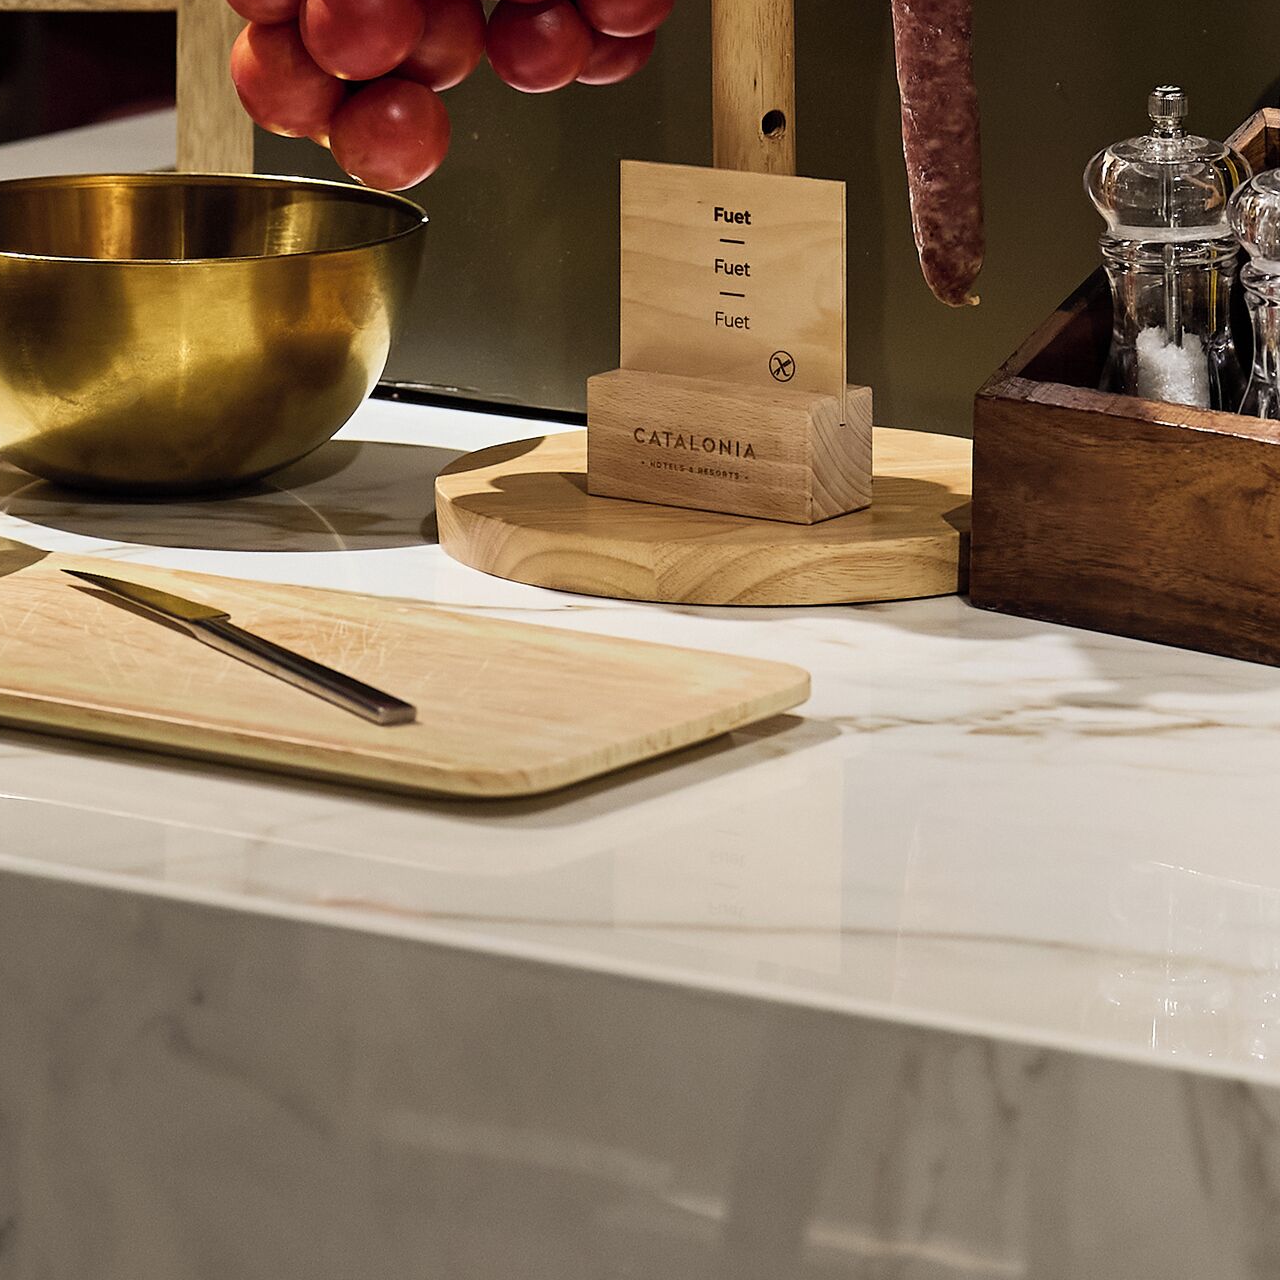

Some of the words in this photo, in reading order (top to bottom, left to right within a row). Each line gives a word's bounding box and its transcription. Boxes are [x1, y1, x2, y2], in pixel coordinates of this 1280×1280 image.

[714, 206, 752, 225] Fuet
[714, 258, 750, 277] Fuet
[715, 311, 750, 330] Fuet
[634, 427, 756, 460] CATALONIA
